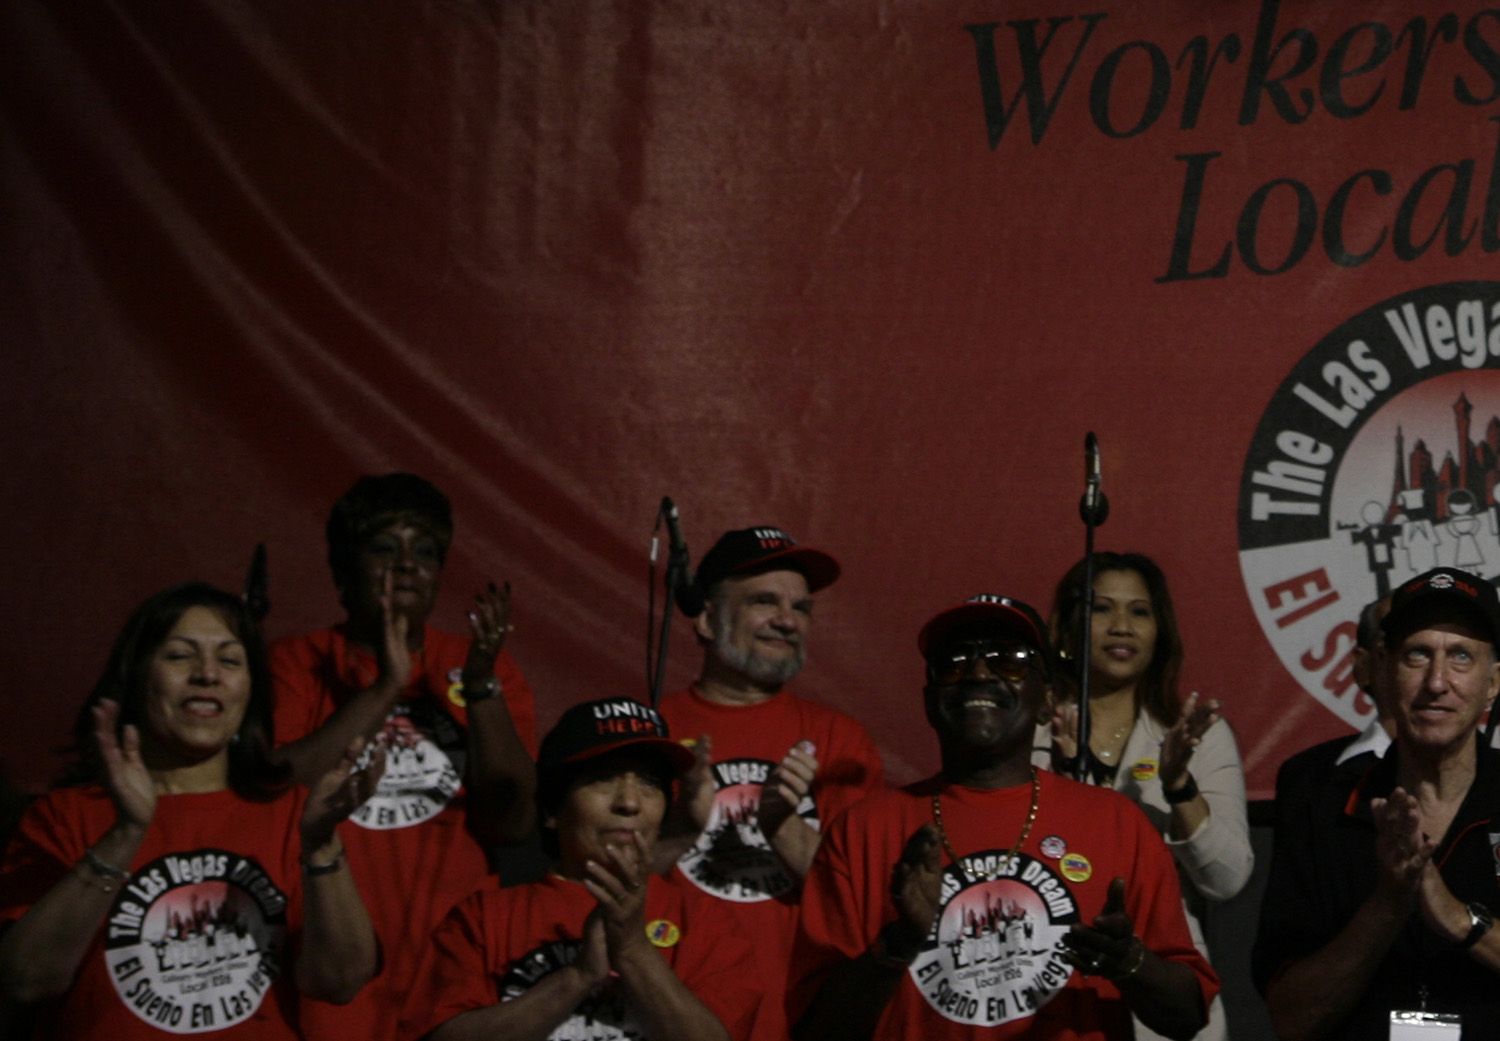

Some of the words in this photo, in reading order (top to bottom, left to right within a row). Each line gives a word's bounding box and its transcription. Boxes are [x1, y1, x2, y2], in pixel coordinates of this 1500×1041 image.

[1251, 429, 1335, 521] The
[1293, 338, 1391, 429] Las
[1263, 567, 1340, 629] El
[715, 762, 770, 784] Vegas
[109, 900, 145, 939] The
[127, 868, 168, 904] Las
[164, 853, 229, 884] Vegas
[1020, 860, 1075, 918] Dream
[114, 956, 143, 982] El
[191, 1003, 214, 1028] En
[220, 990, 253, 1022] Las
[917, 960, 942, 985] El
[986, 996, 1007, 1022] En
